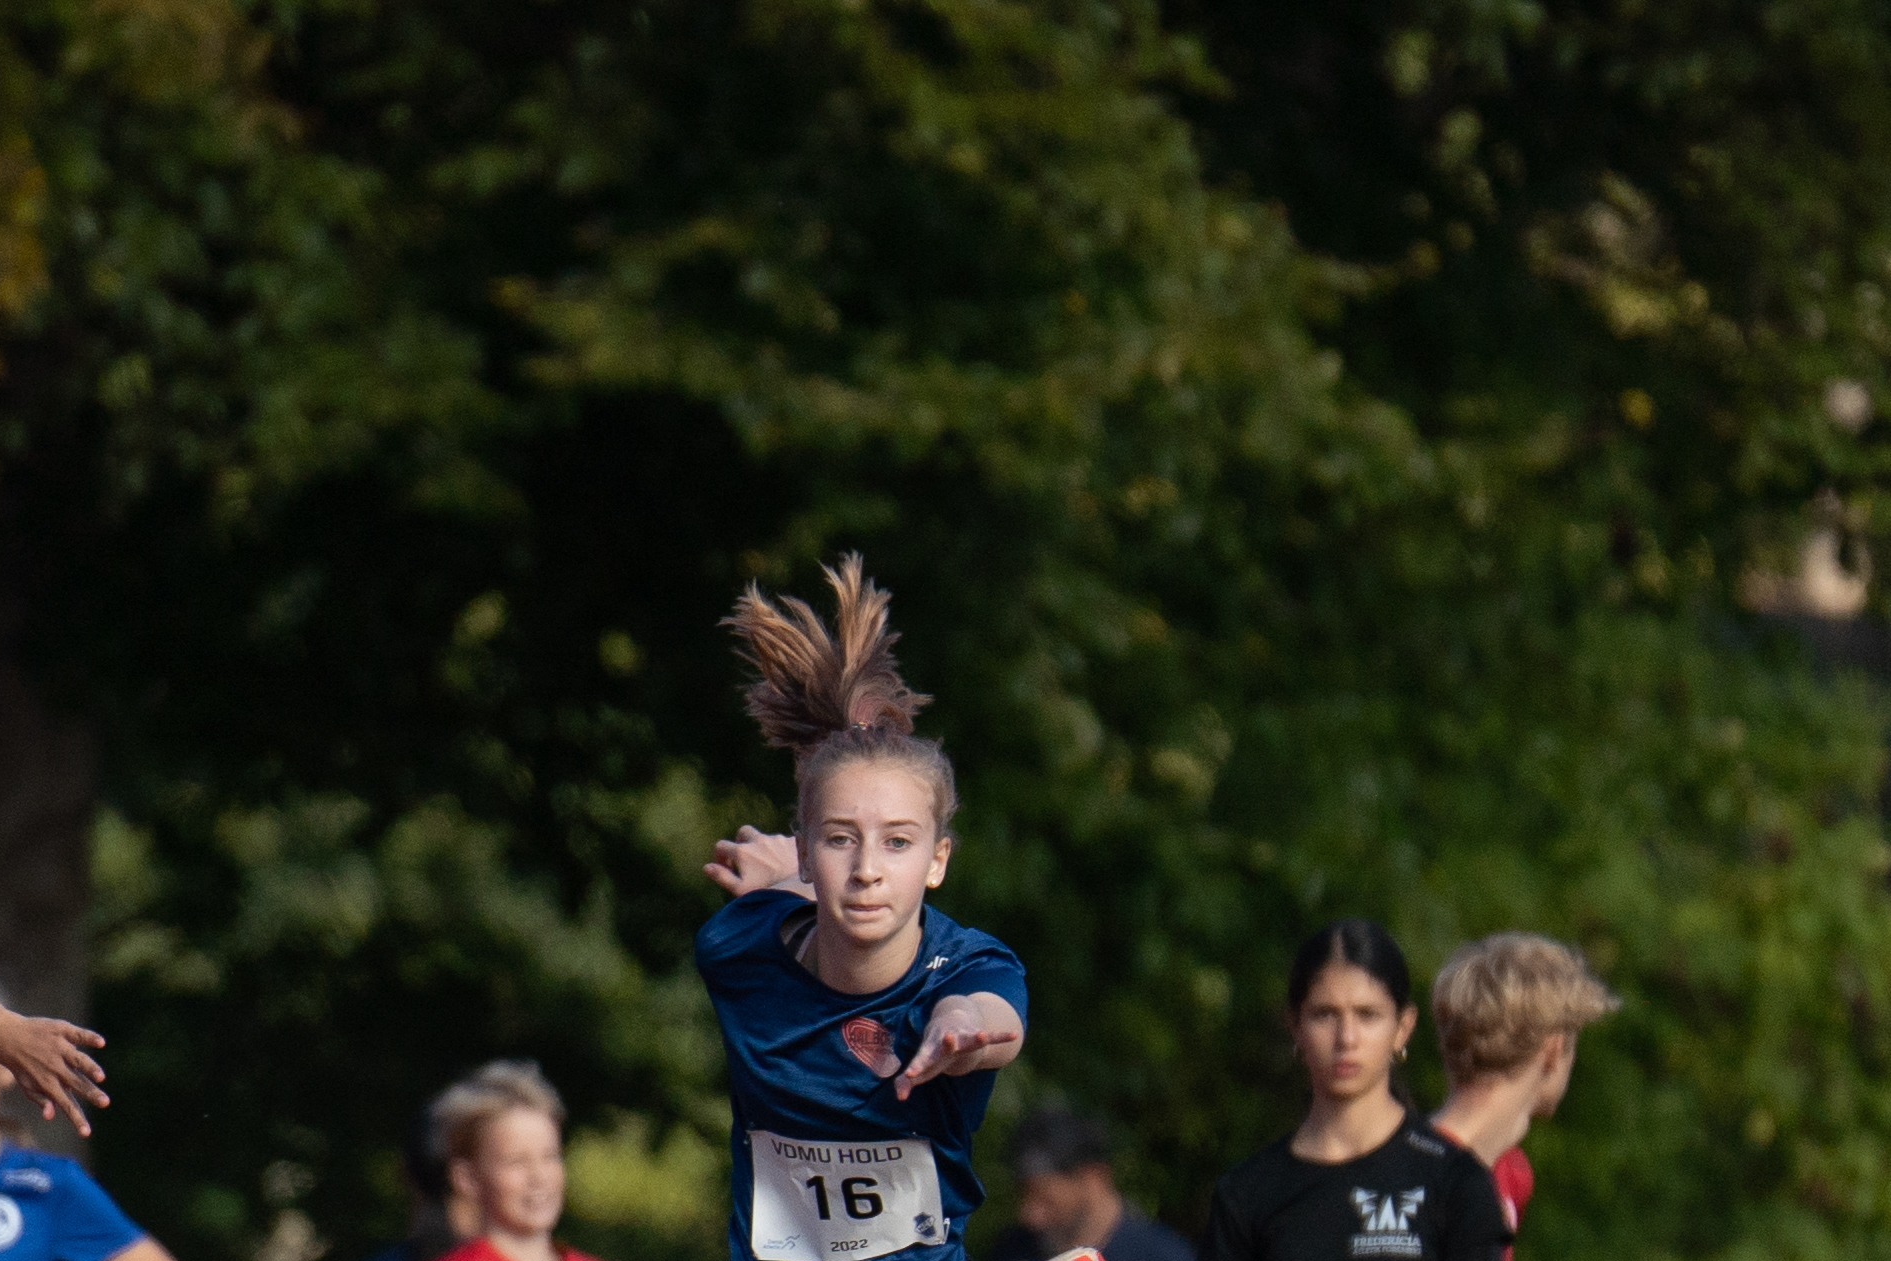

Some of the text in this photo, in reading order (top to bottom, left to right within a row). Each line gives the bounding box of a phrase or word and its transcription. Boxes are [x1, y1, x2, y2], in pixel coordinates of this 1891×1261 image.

[770, 1138, 903, 1164] VDMU HOLD
[805, 1175, 884, 1221] 16
[829, 1238, 868, 1252] 2022
